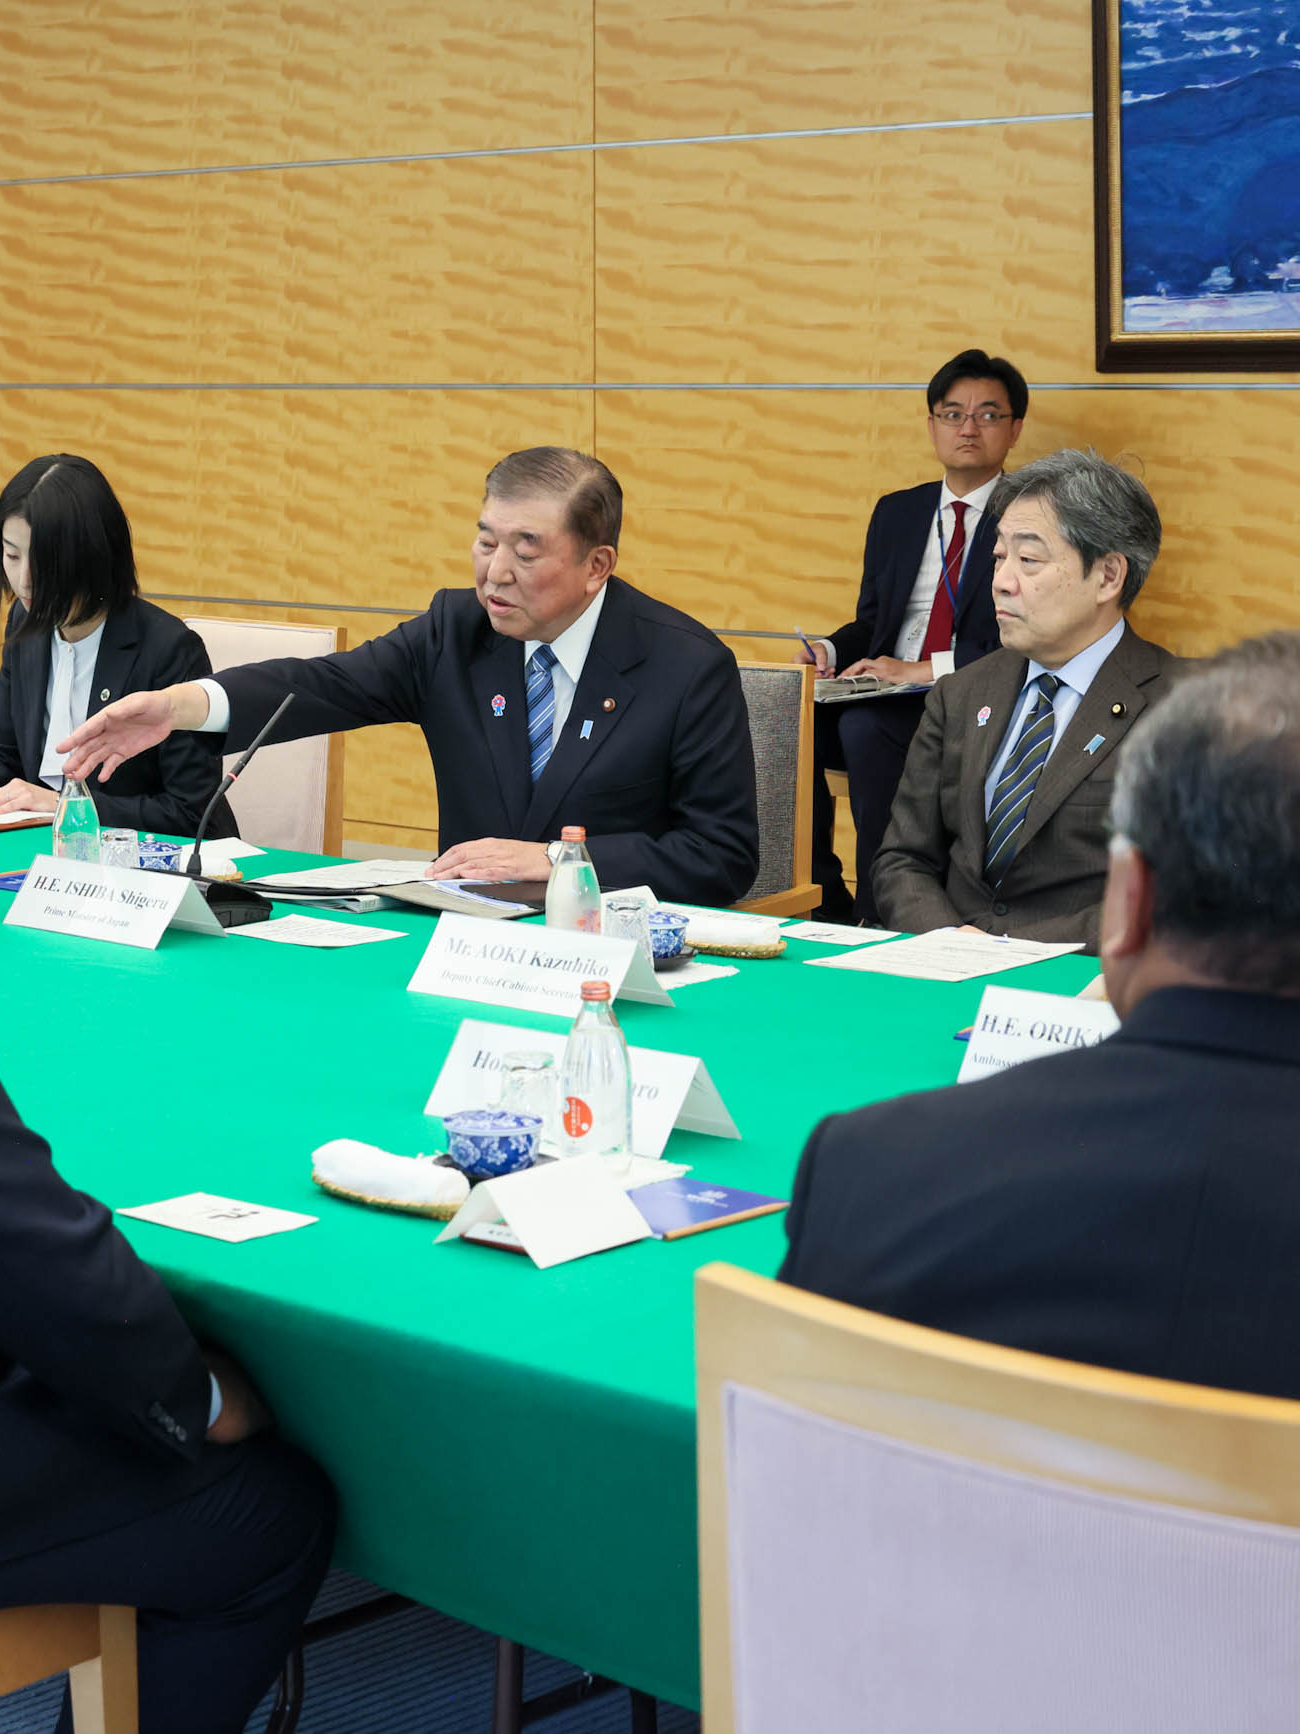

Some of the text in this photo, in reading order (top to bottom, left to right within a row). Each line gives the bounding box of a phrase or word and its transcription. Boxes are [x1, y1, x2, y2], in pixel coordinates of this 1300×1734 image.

[33, 874, 170, 911] H.E. ISHIBA Shigeru
[43, 904, 66, 918] Prime
[444, 936, 609, 977] Mr. AOKI Kazuhiko
[441, 967, 580, 1000] Deputy Chief Cabinet Secretar
[980, 1014, 1021, 1037] H.E.
